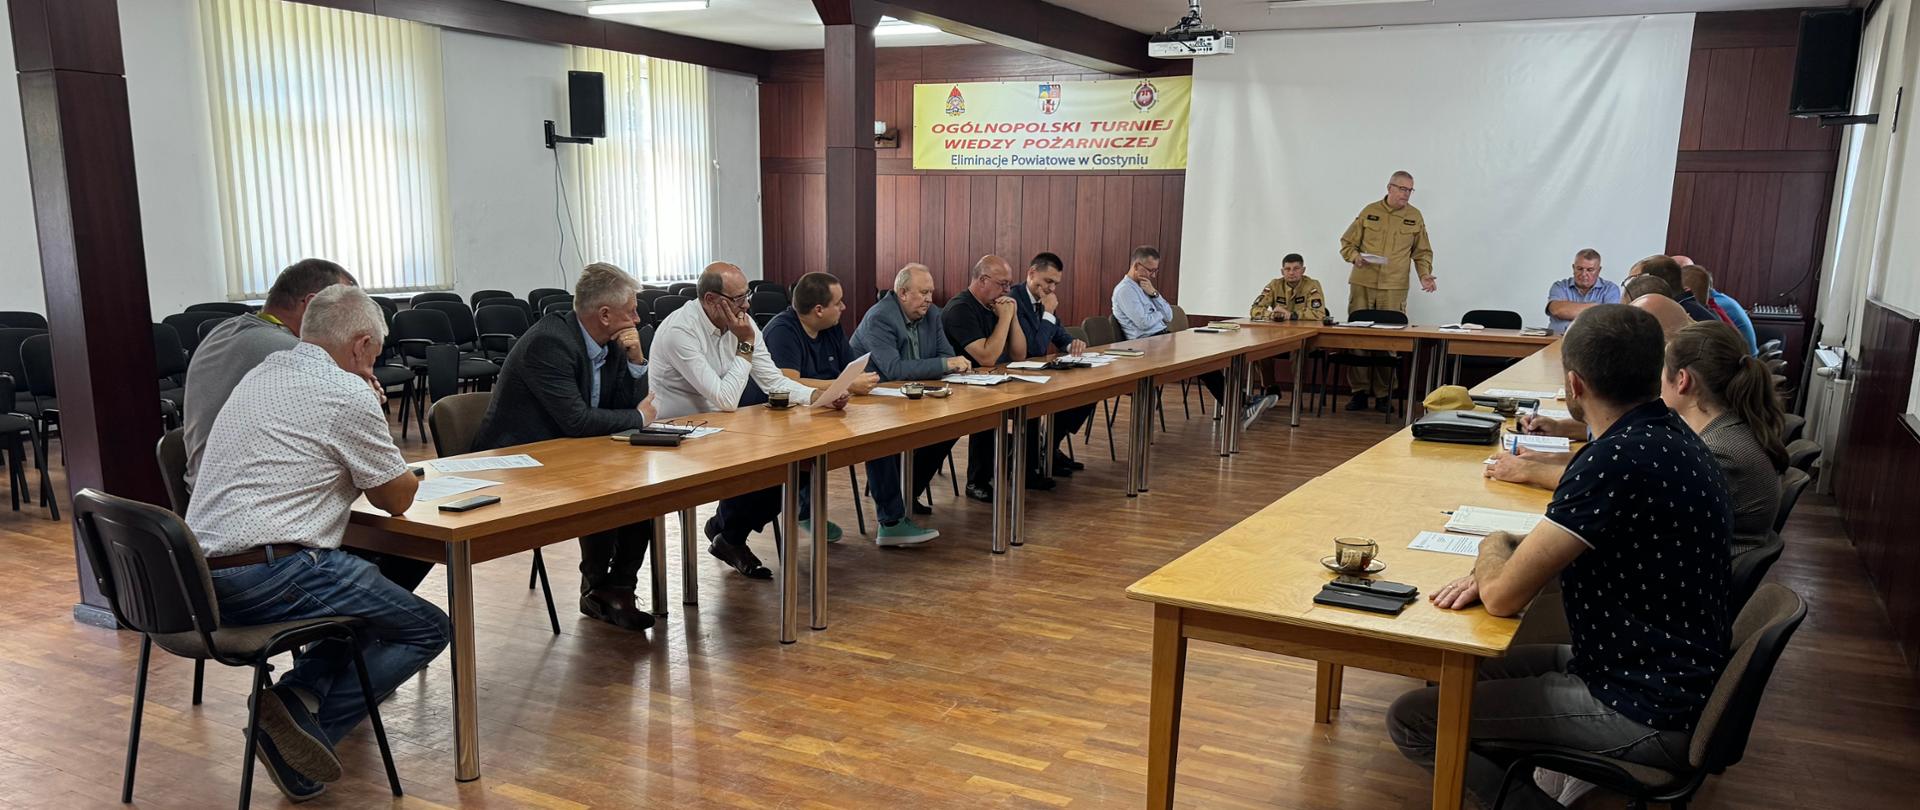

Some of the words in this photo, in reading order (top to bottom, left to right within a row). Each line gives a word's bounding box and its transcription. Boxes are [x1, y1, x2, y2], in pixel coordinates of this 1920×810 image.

[931, 121, 1081, 134] OGÓLNOPOLSKI
[1090, 119, 1173, 132] TURNIEJ
[944, 138, 1014, 149] WIEDZY
[1023, 136, 1158, 149] POŻARNICZEJ
[951, 154, 1008, 166] Eliminacje
[1011, 155, 1075, 165] Powiatowe
[1078, 157, 1089, 165] w
[1092, 154, 1148, 166] Gostyniu
